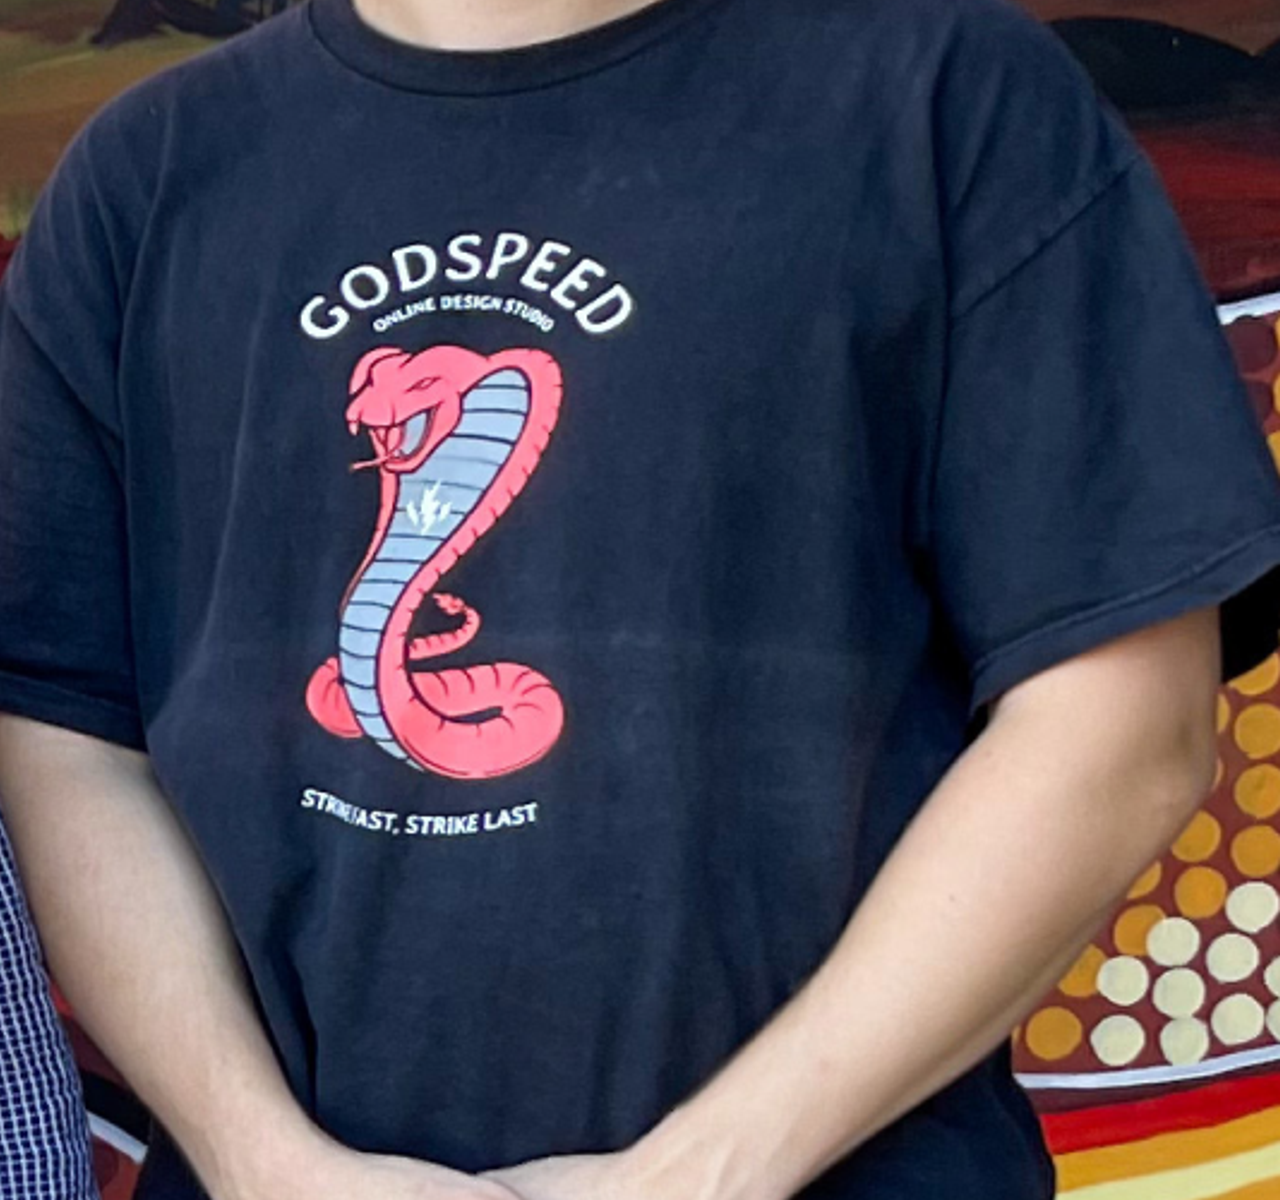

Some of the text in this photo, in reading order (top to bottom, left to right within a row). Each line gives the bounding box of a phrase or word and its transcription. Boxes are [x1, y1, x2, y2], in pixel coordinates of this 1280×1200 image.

[299, 232, 634, 340] GODSPEED
[371, 294, 556, 333] ONLINE DESIGN STUDIO
[300, 788, 351, 822] STR
[404, 814, 480, 836] STRIKE
[483, 801, 538, 832] LAST
